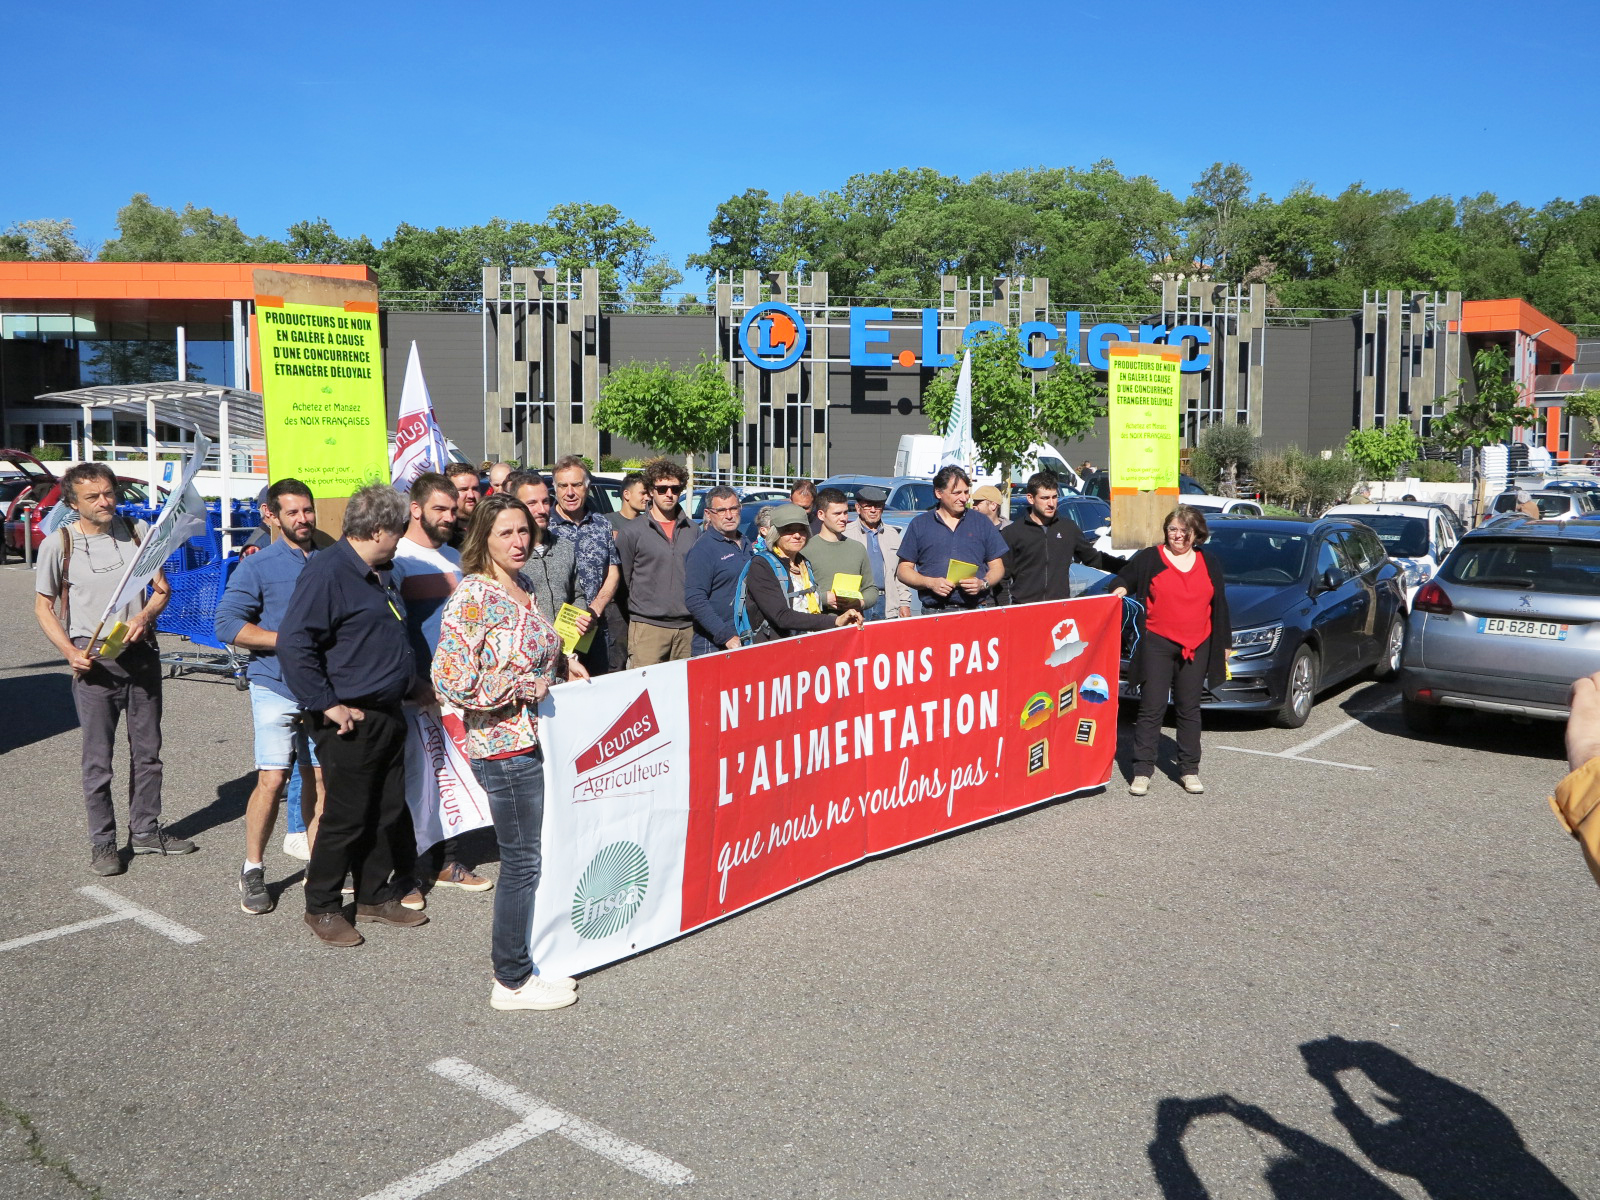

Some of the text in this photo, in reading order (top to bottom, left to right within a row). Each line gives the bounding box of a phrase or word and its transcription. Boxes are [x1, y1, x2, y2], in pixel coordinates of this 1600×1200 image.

[265, 311, 372, 331] PRODUCTEURS DE NOIX
[276, 329, 365, 346] EN GALÈRE À CAUSE
[273, 346, 371, 363] D'UNE CONCURRENCE
[274, 361, 372, 379] ÉTRANGÈRE DÉLOYALE
[1114, 360, 1177, 373] PRODUCTEURS DE NOIX
[1119, 372, 1127, 381] EN
[1153, 374, 1171, 384] CAUSE
[1134, 384, 1173, 396] CONCURRENCE
[292, 402, 322, 412] Achetez
[324, 403, 332, 412] et
[284, 416, 370, 428] des NOIX FRANÇAISES
[1488, 619, 1557, 636] EQ-628-CQ
[719, 637, 1000, 733] N'IMPORTONS PAS
[595, 713, 652, 766] Jeunes
[718, 688, 999, 807] L'ALIMENTATION
[424, 724, 464, 827] Agriculteurs
[582, 759, 671, 798] Agriculteurs
[716, 830, 765, 904] que
[767, 804, 823, 855] nous
[826, 797, 856, 830] ne
[858, 756, 946, 818] voulons
[945, 756, 989, 818] pas
[993, 736, 1004, 778] !
[582, 884, 640, 927] fnsea
